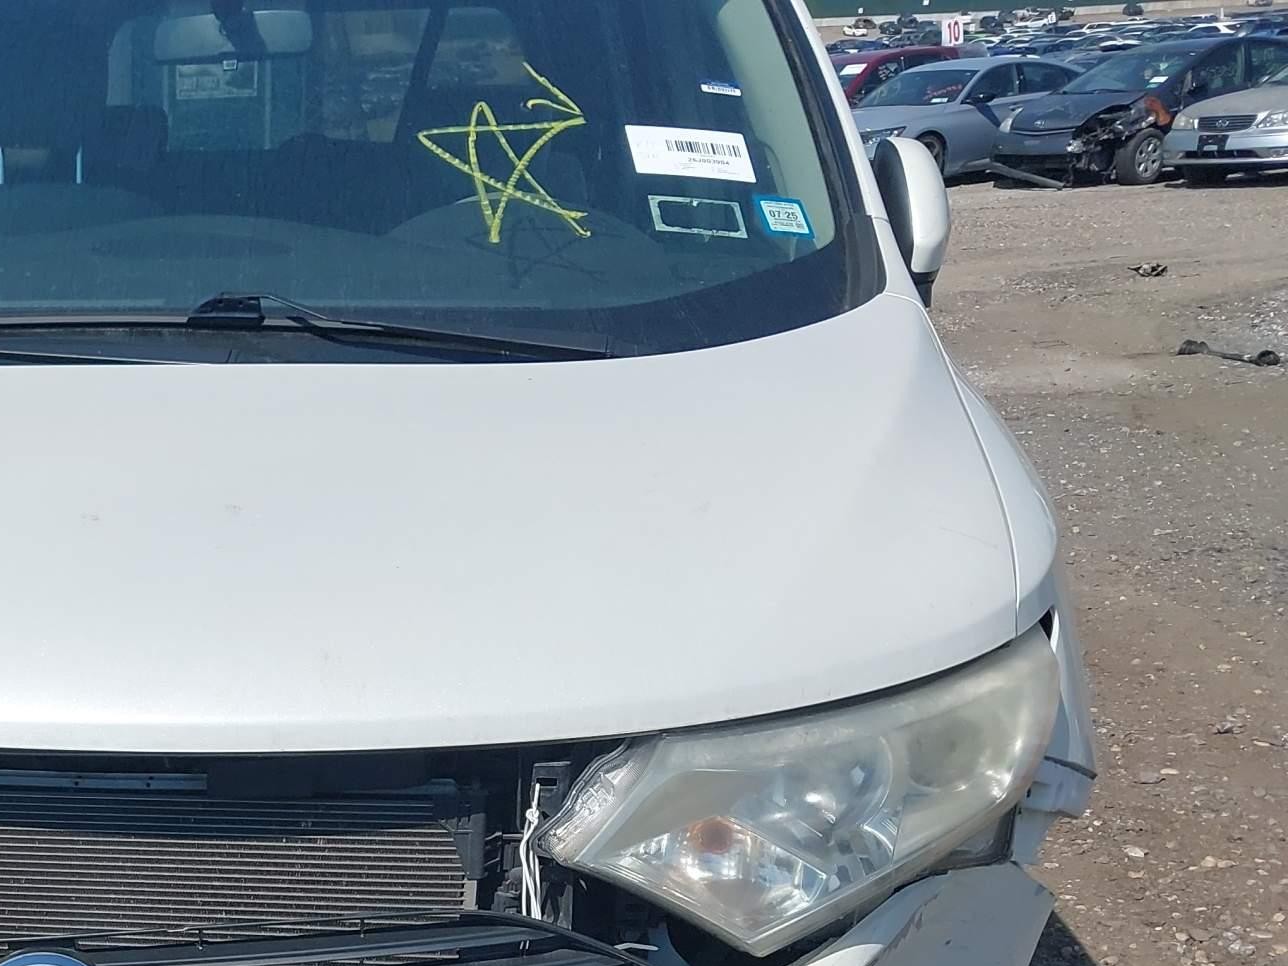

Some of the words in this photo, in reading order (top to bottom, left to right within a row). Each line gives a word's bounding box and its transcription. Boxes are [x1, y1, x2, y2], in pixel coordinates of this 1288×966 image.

[947, 21, 960, 44] 10
[768, 209, 781, 218] 07
[784, 211, 798, 221] 25
